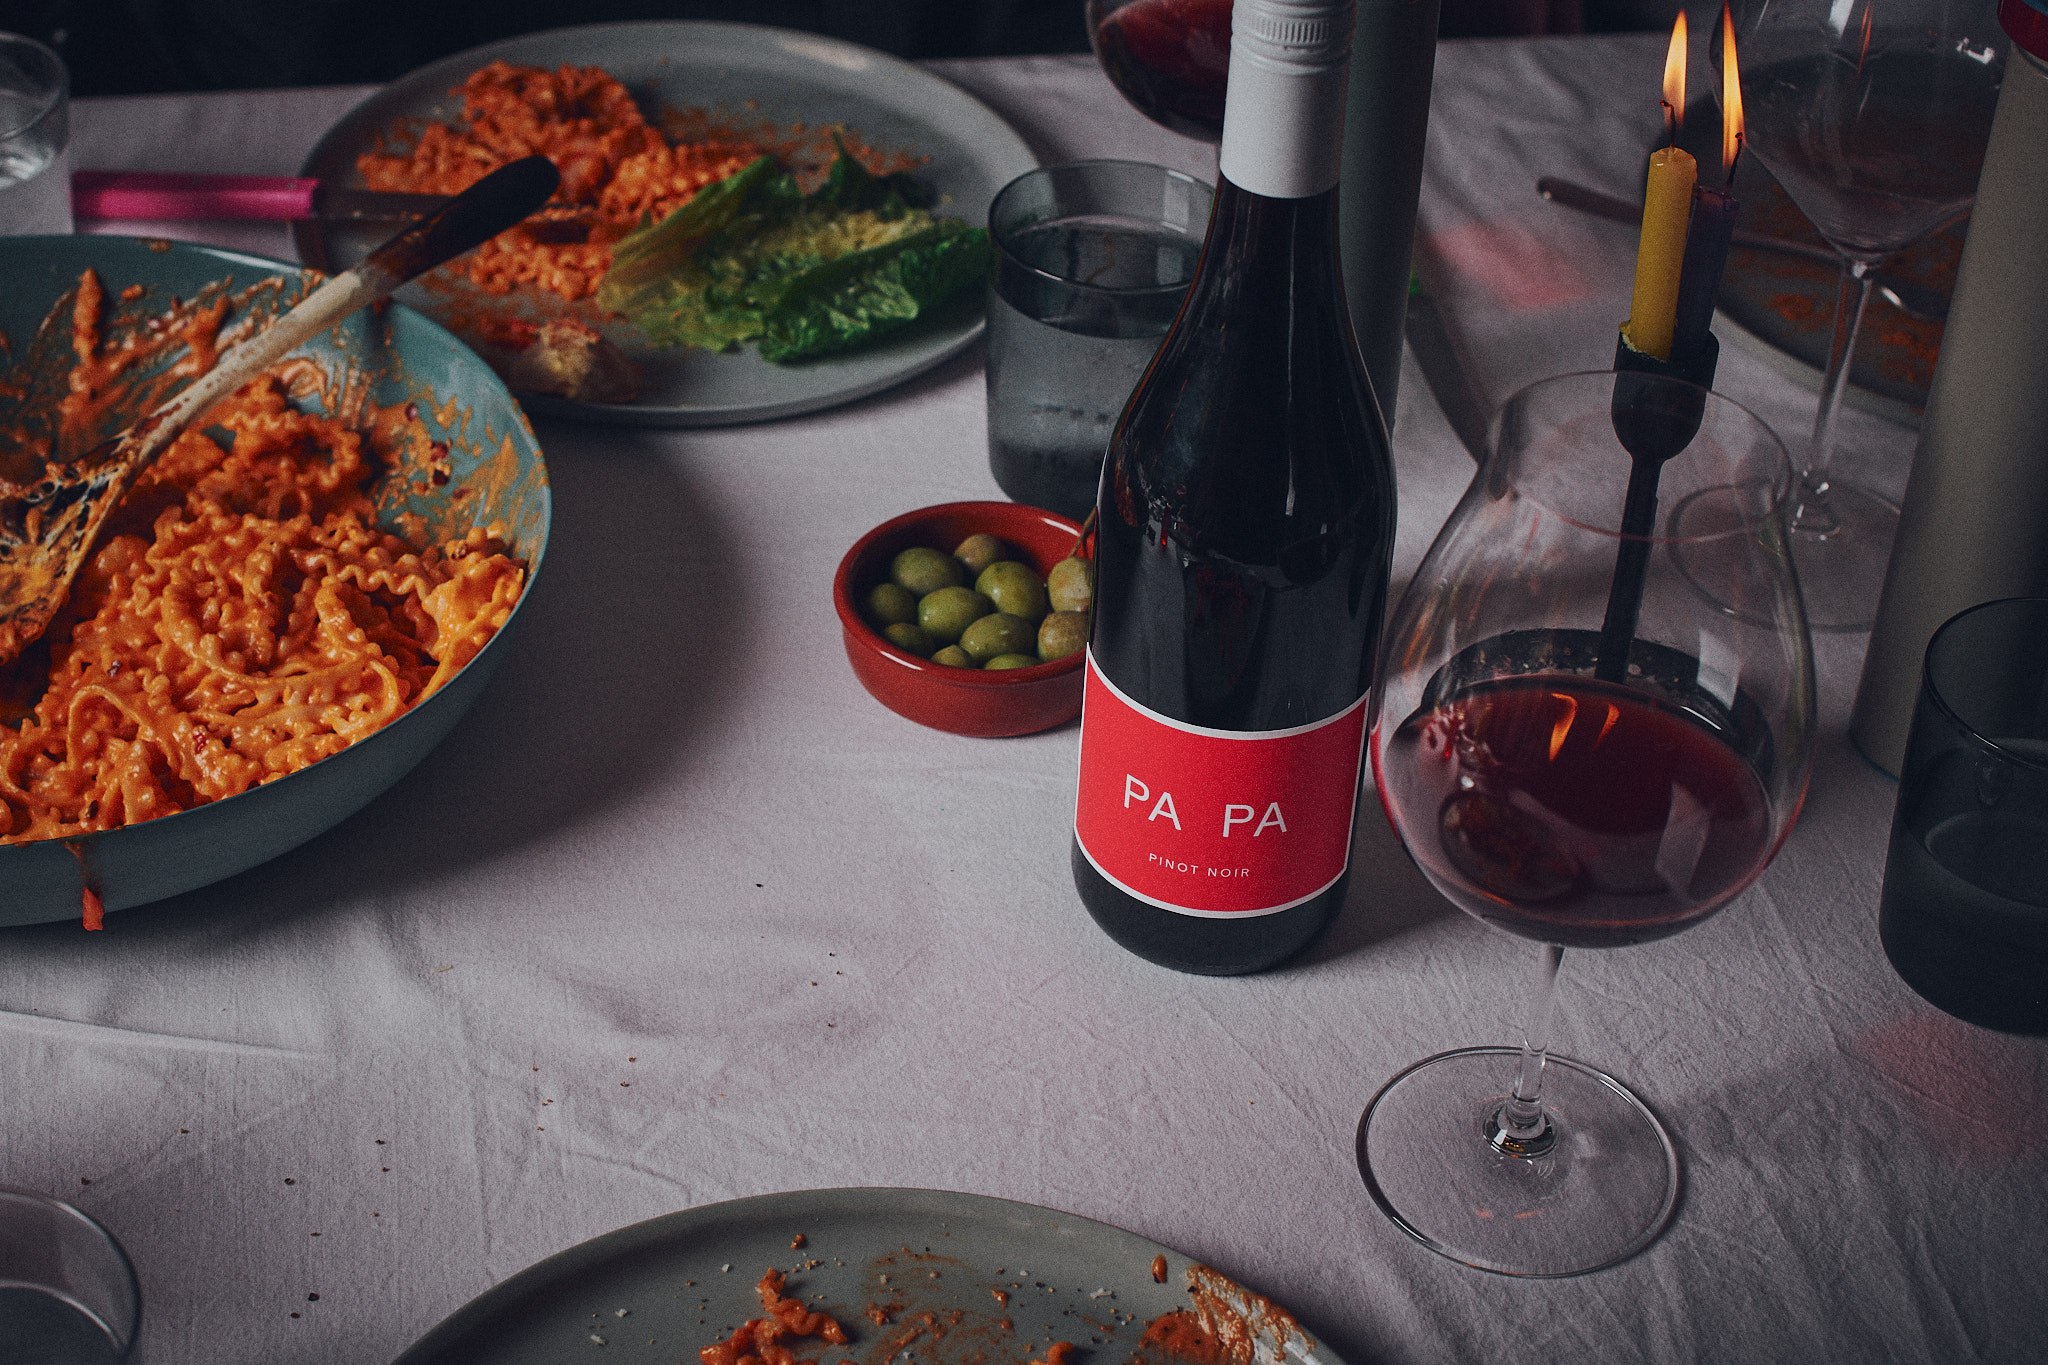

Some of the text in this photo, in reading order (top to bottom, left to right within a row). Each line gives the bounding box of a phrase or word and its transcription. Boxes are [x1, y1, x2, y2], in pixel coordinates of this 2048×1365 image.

[1124, 773, 1288, 838] PA PA
[1148, 852, 1251, 878] PINOT NOIR
